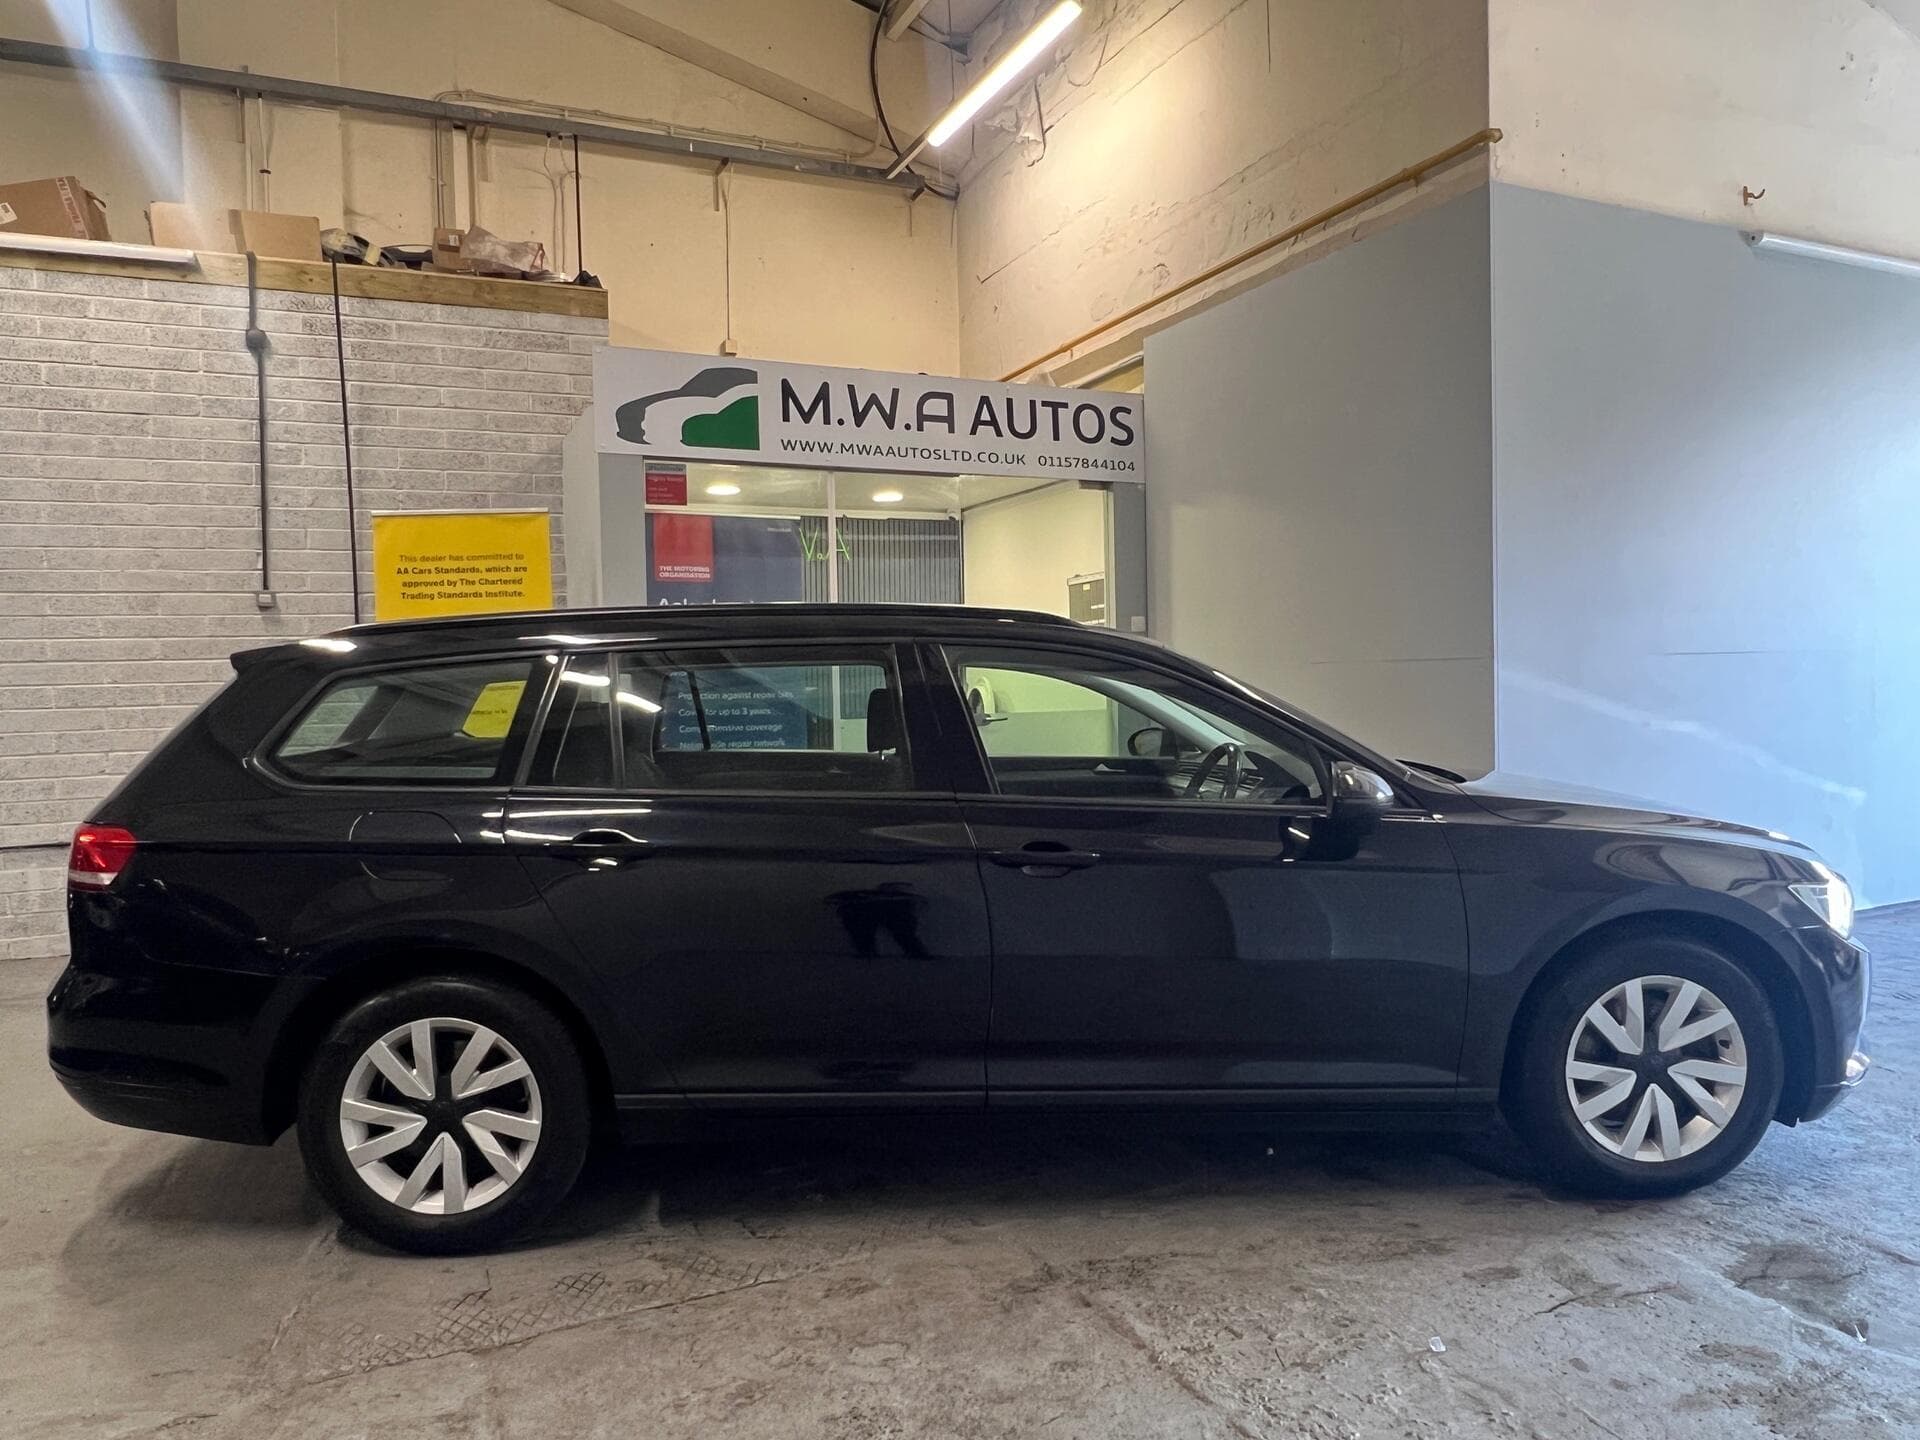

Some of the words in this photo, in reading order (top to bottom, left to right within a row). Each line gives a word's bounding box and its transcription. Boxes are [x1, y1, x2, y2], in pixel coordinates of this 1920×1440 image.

[781, 378, 955, 434] M.W.A
[969, 395, 1135, 446] AUTOS
[781, 438, 1026, 466] WWW.MWAAUTOSLTD.CO.UK
[1038, 455, 1136, 472] 01157844104
[400, 555, 417, 563] This
[466, 553, 513, 561] committed
[396, 567, 409, 575] AA
[411, 567, 432, 575] Cars
[434, 566, 483, 574] Standards,
[485, 565, 512, 573] which
[402, 579, 445, 588] approved
[446, 579, 458, 588] by
[459, 578, 476, 586] The
[478, 577, 523, 586] Chartered
[400, 591, 435, 601] Trading
[437, 590, 483, 599] Standards
[485, 589, 526, 598] Institute.
[678, 691, 720, 700] Proction
[679, 724, 744, 733] Comhensive
